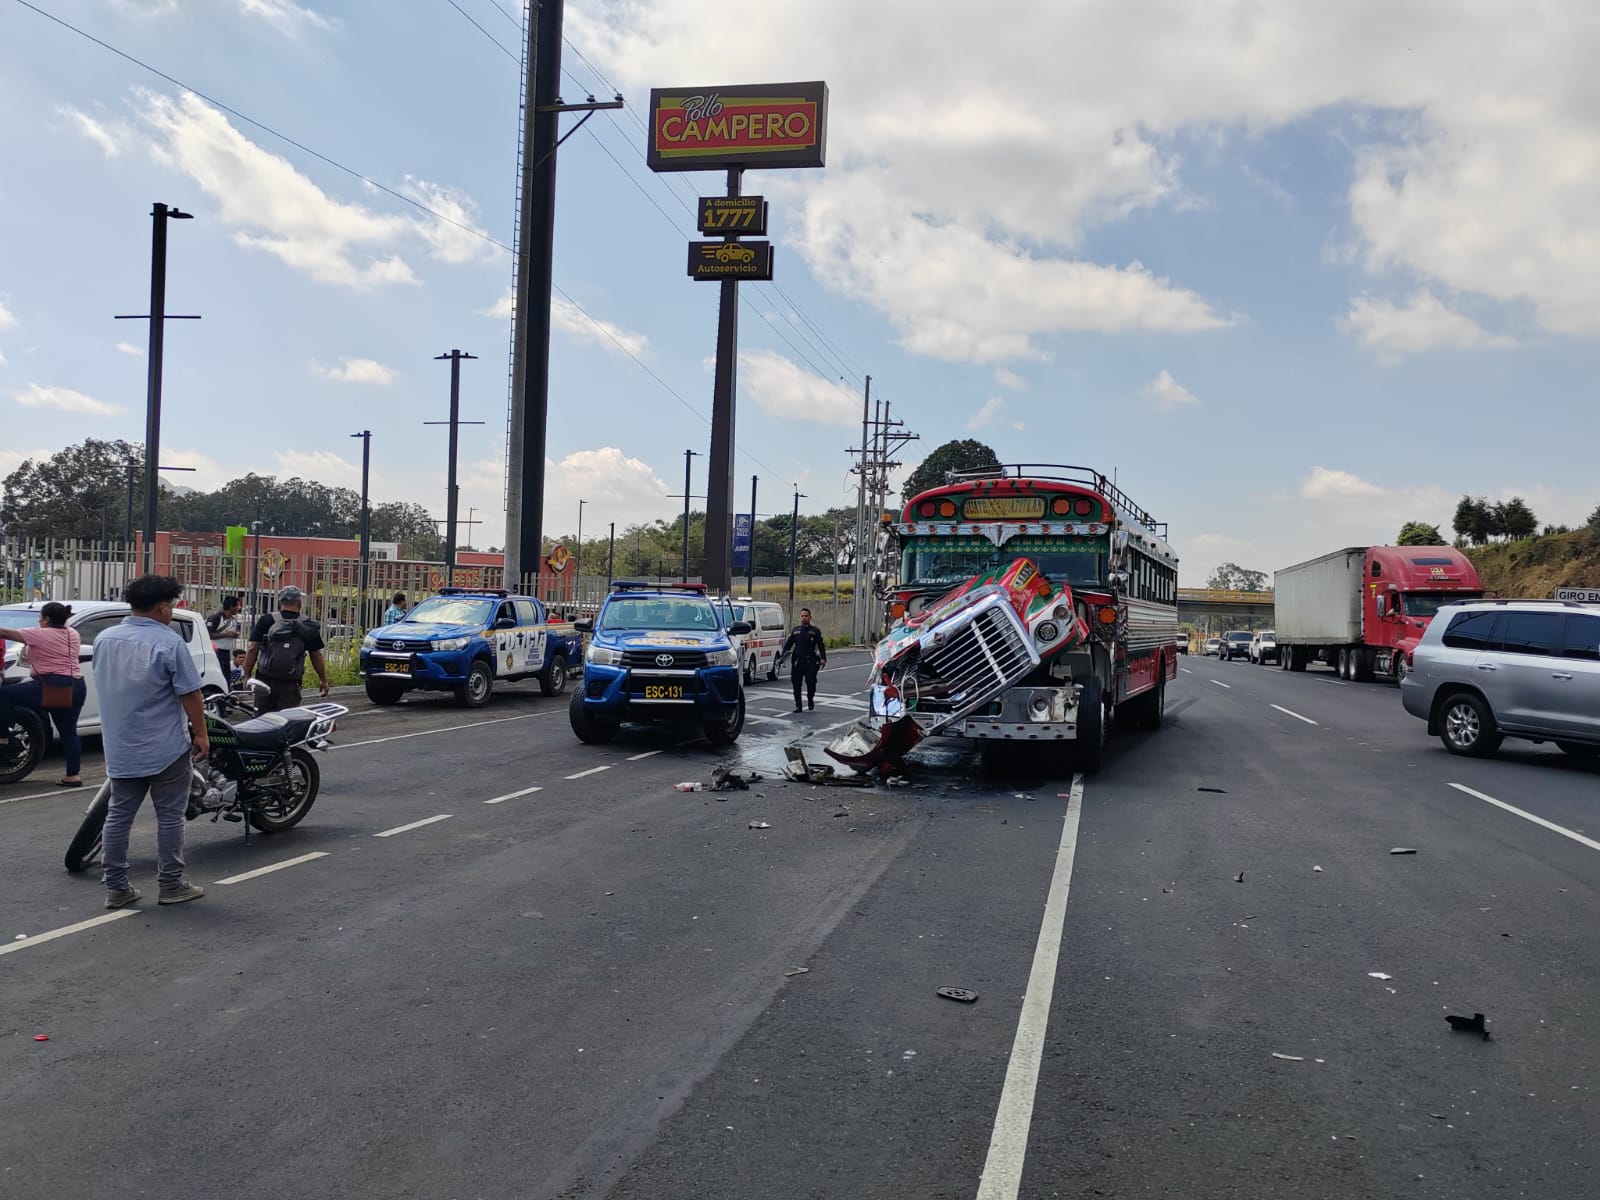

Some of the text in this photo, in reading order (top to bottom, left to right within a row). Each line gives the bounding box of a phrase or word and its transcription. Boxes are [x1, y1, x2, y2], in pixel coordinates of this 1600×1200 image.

[681, 92, 723, 122] Pollo
[662, 112, 810, 142] CAMPERO
[706, 198, 757, 207] A domicilio
[704, 208, 756, 228] 1777
[698, 264, 757, 273] Autoservicio
[1559, 591, 1586, 600] GIRO
[645, 685, 683, 698] ESC-131
